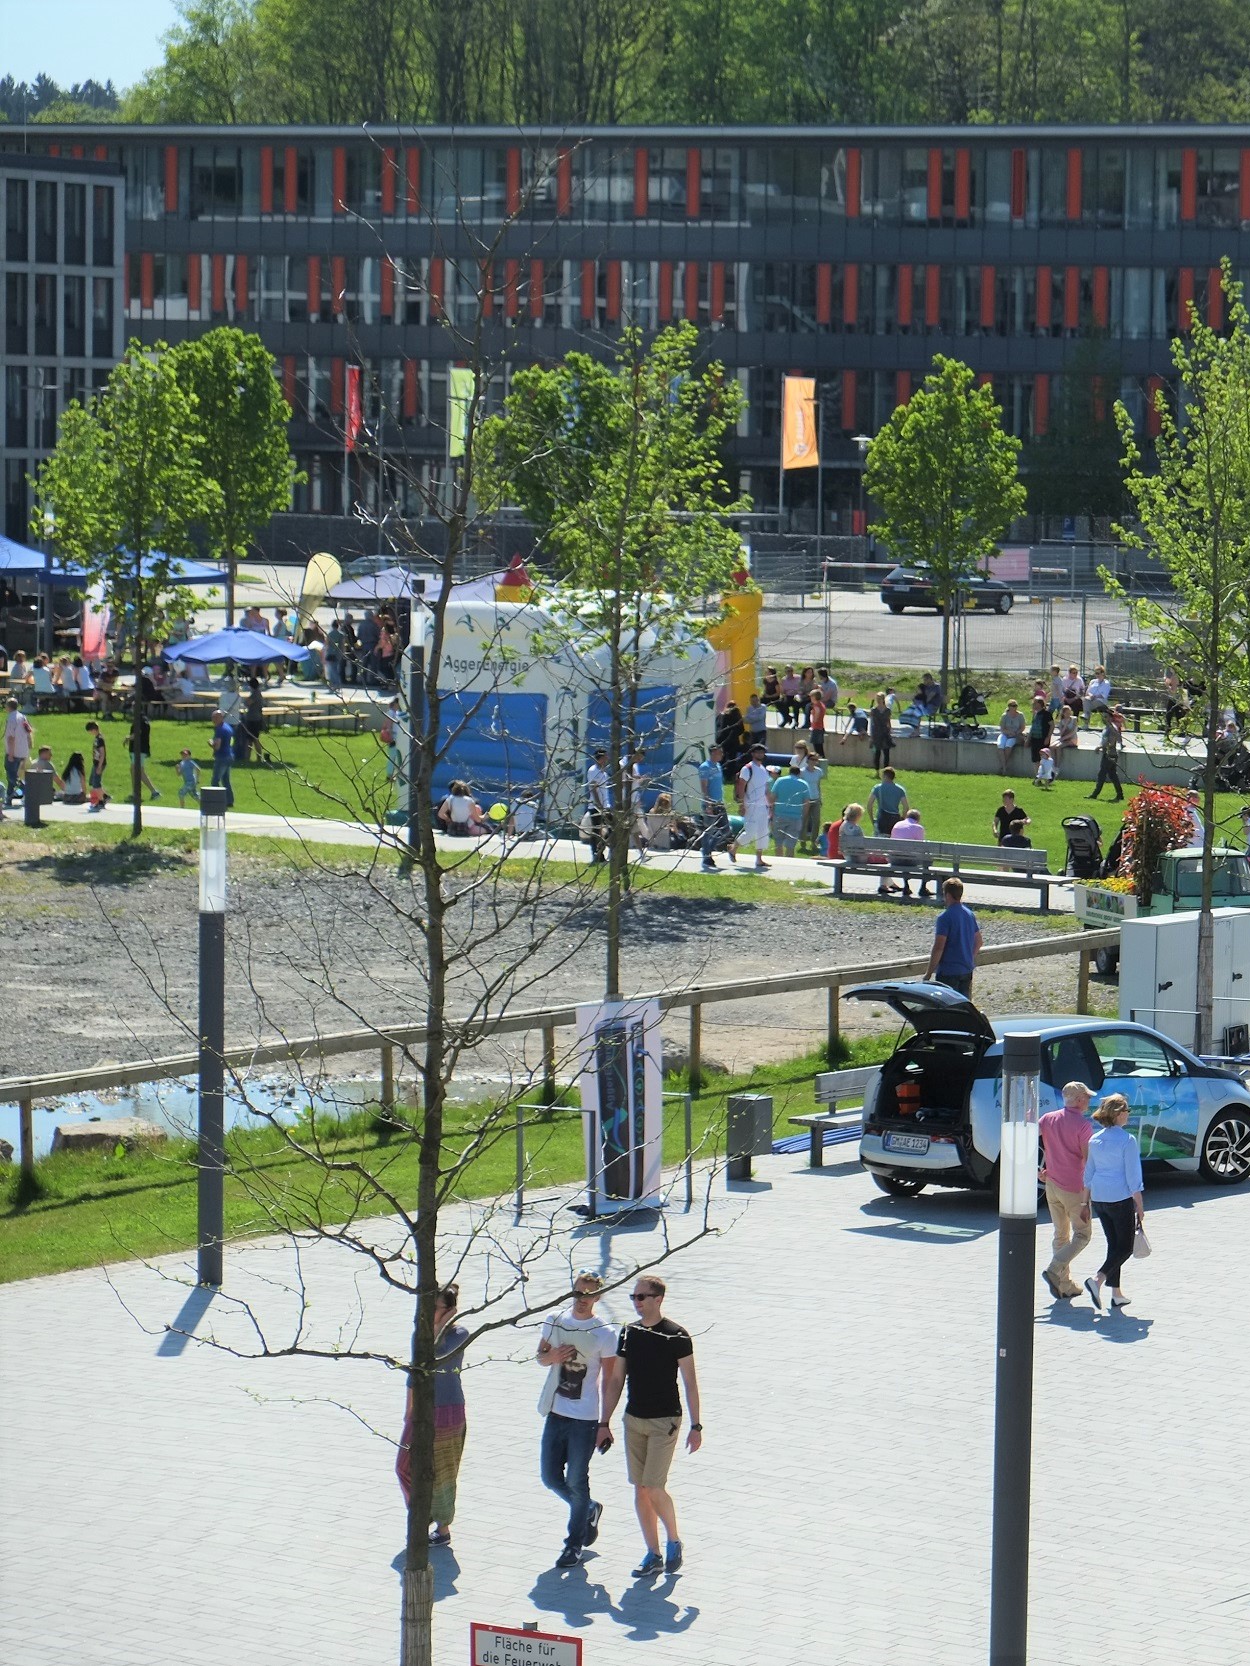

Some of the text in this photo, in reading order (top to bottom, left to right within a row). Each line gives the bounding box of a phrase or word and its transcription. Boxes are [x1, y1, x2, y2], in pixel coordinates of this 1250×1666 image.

[443, 654, 529, 674] AggerEnergie
[912, 1138, 927, 1149] 1234
[494, 1635, 556, 1657] Fläche für
[482, 1650, 567, 1666] die Feuerweh
